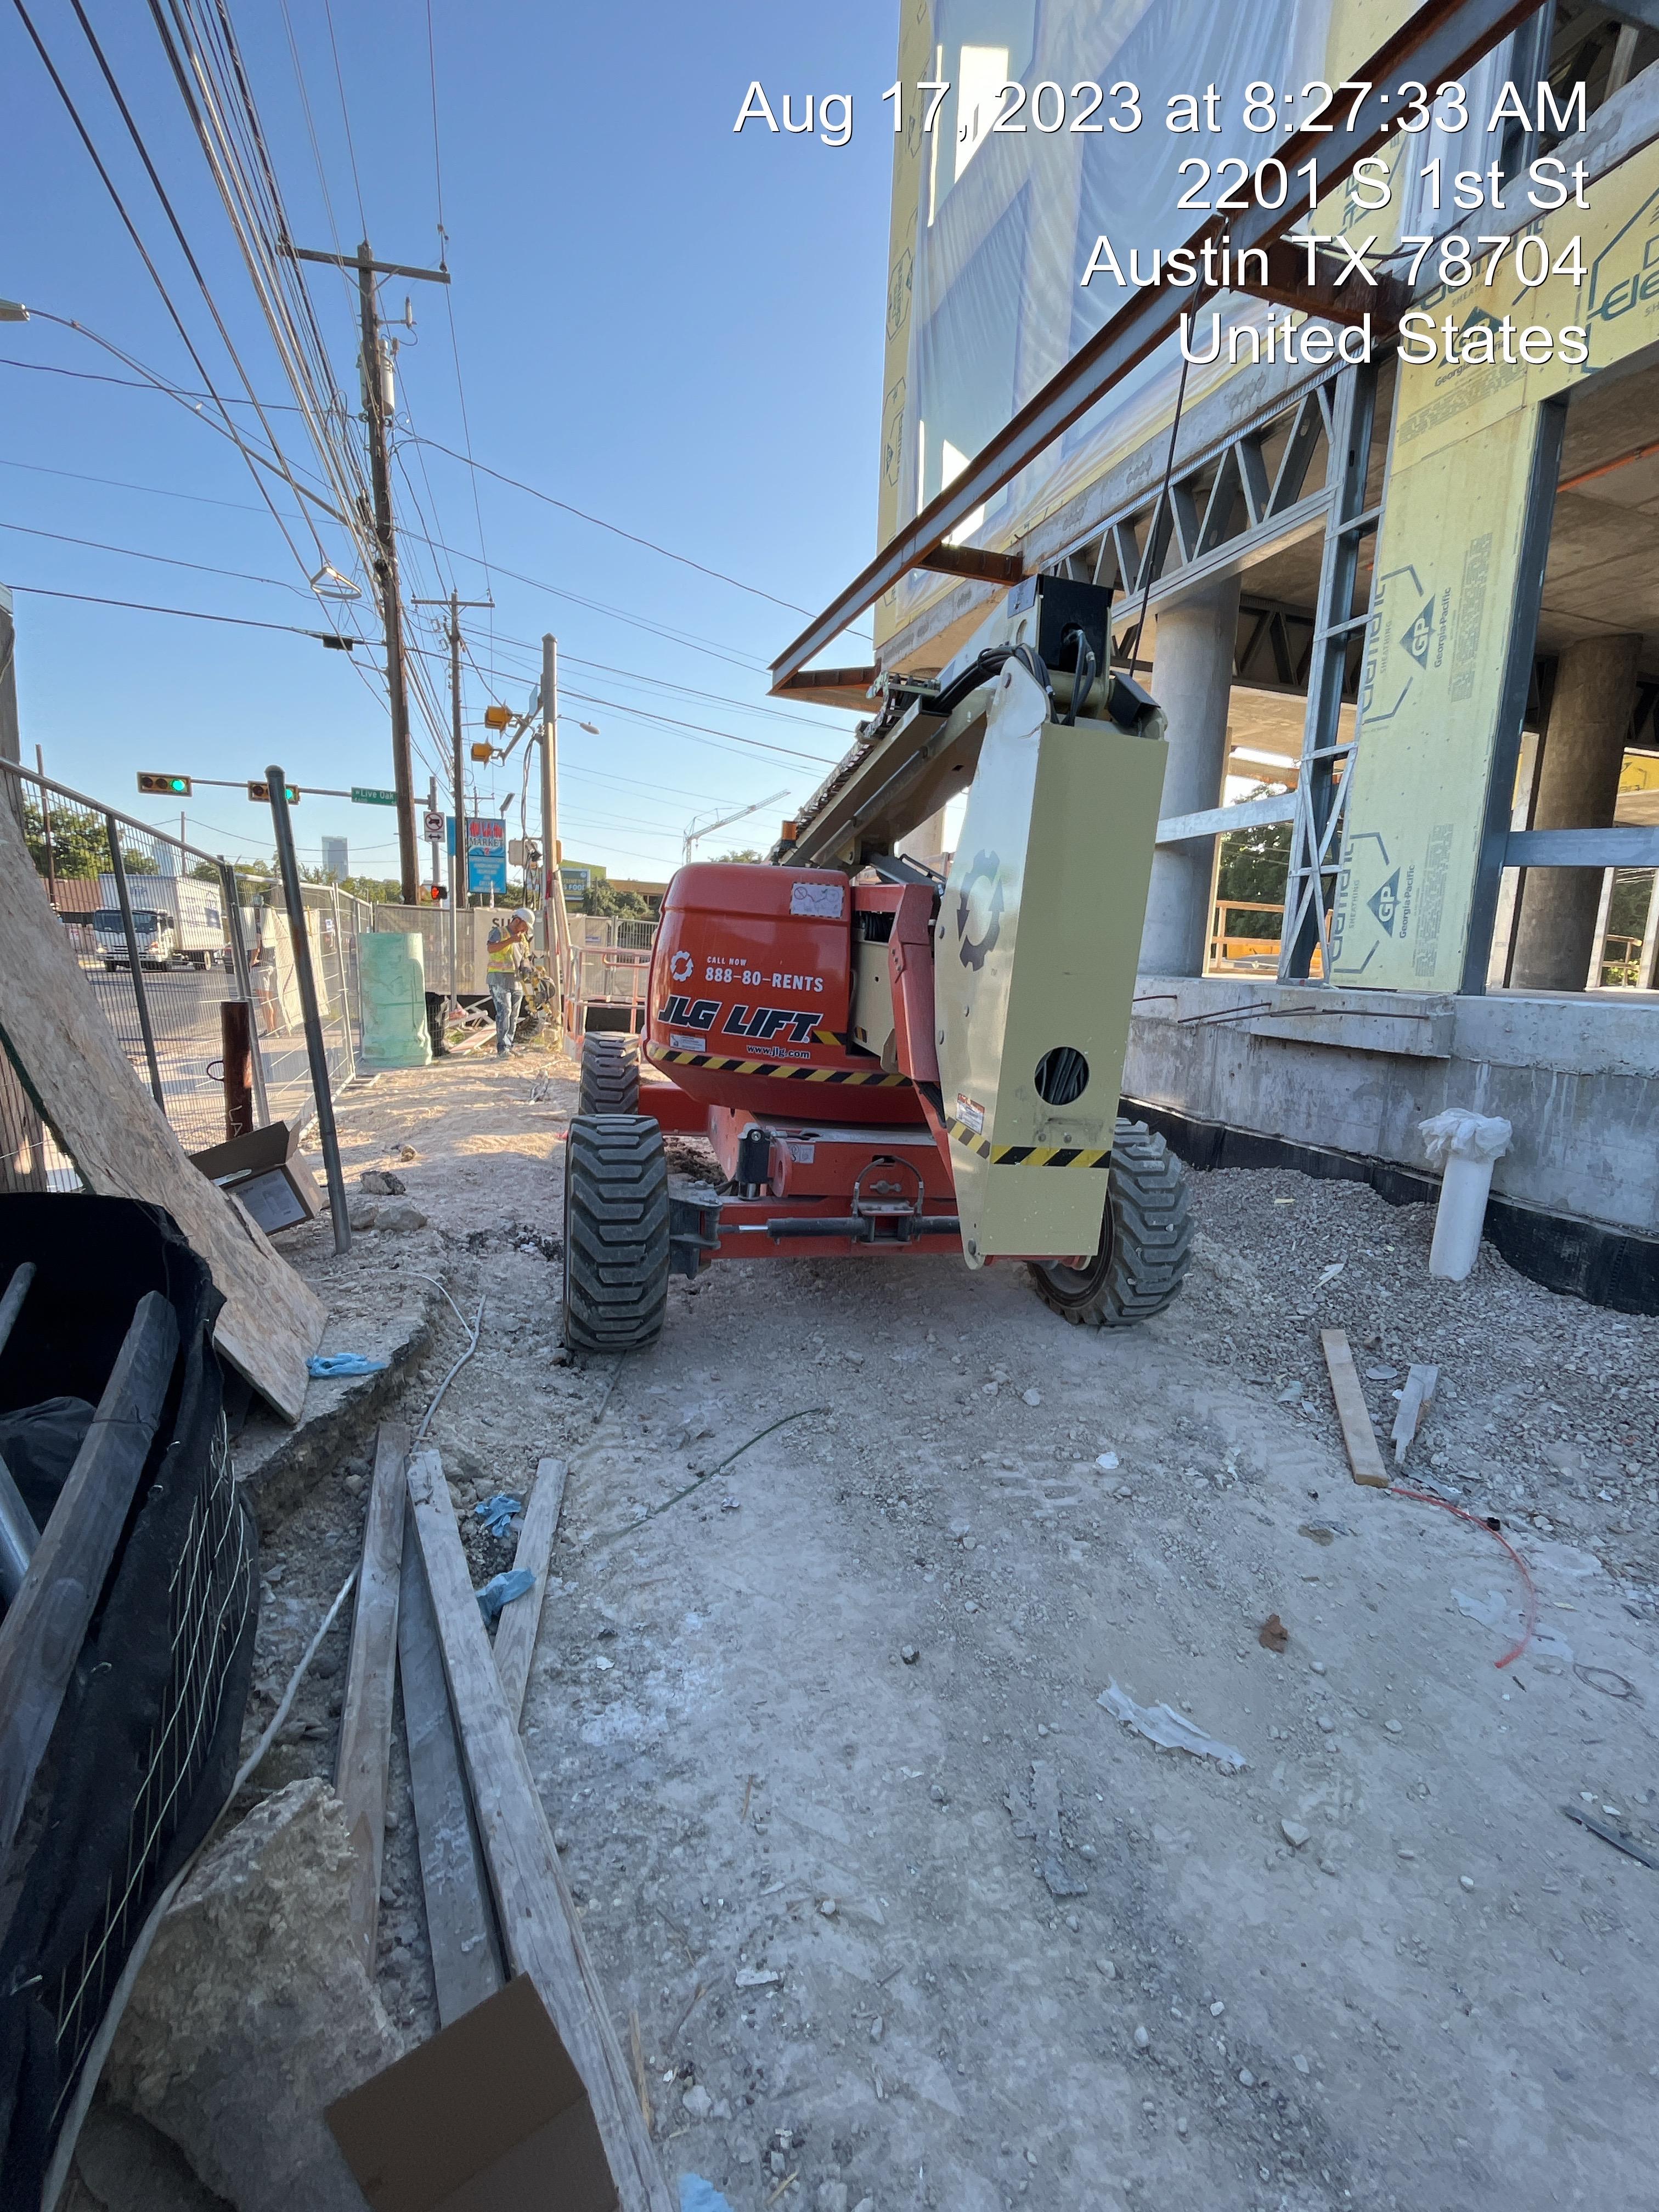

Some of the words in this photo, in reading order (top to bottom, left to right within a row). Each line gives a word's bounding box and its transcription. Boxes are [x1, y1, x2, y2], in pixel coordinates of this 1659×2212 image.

[1380, 620, 1392, 674] SHEATHING
[1412, 618, 1430, 657] GP
[361, 790, 377, 799] Live
[380, 791, 394, 800] Oak
[469, 837, 504, 847] MARKET
[1348, 879, 1361, 929] SHEATHING
[1378, 885, 1397, 923] GP
[707, 956, 726, 965] CALL
[729, 957, 747, 967] NOW
[705, 967, 823, 992] 888-80-RENTS
[657, 994, 723, 1031] JLG
[746, 1045, 811, 1059] www.jlg.com
